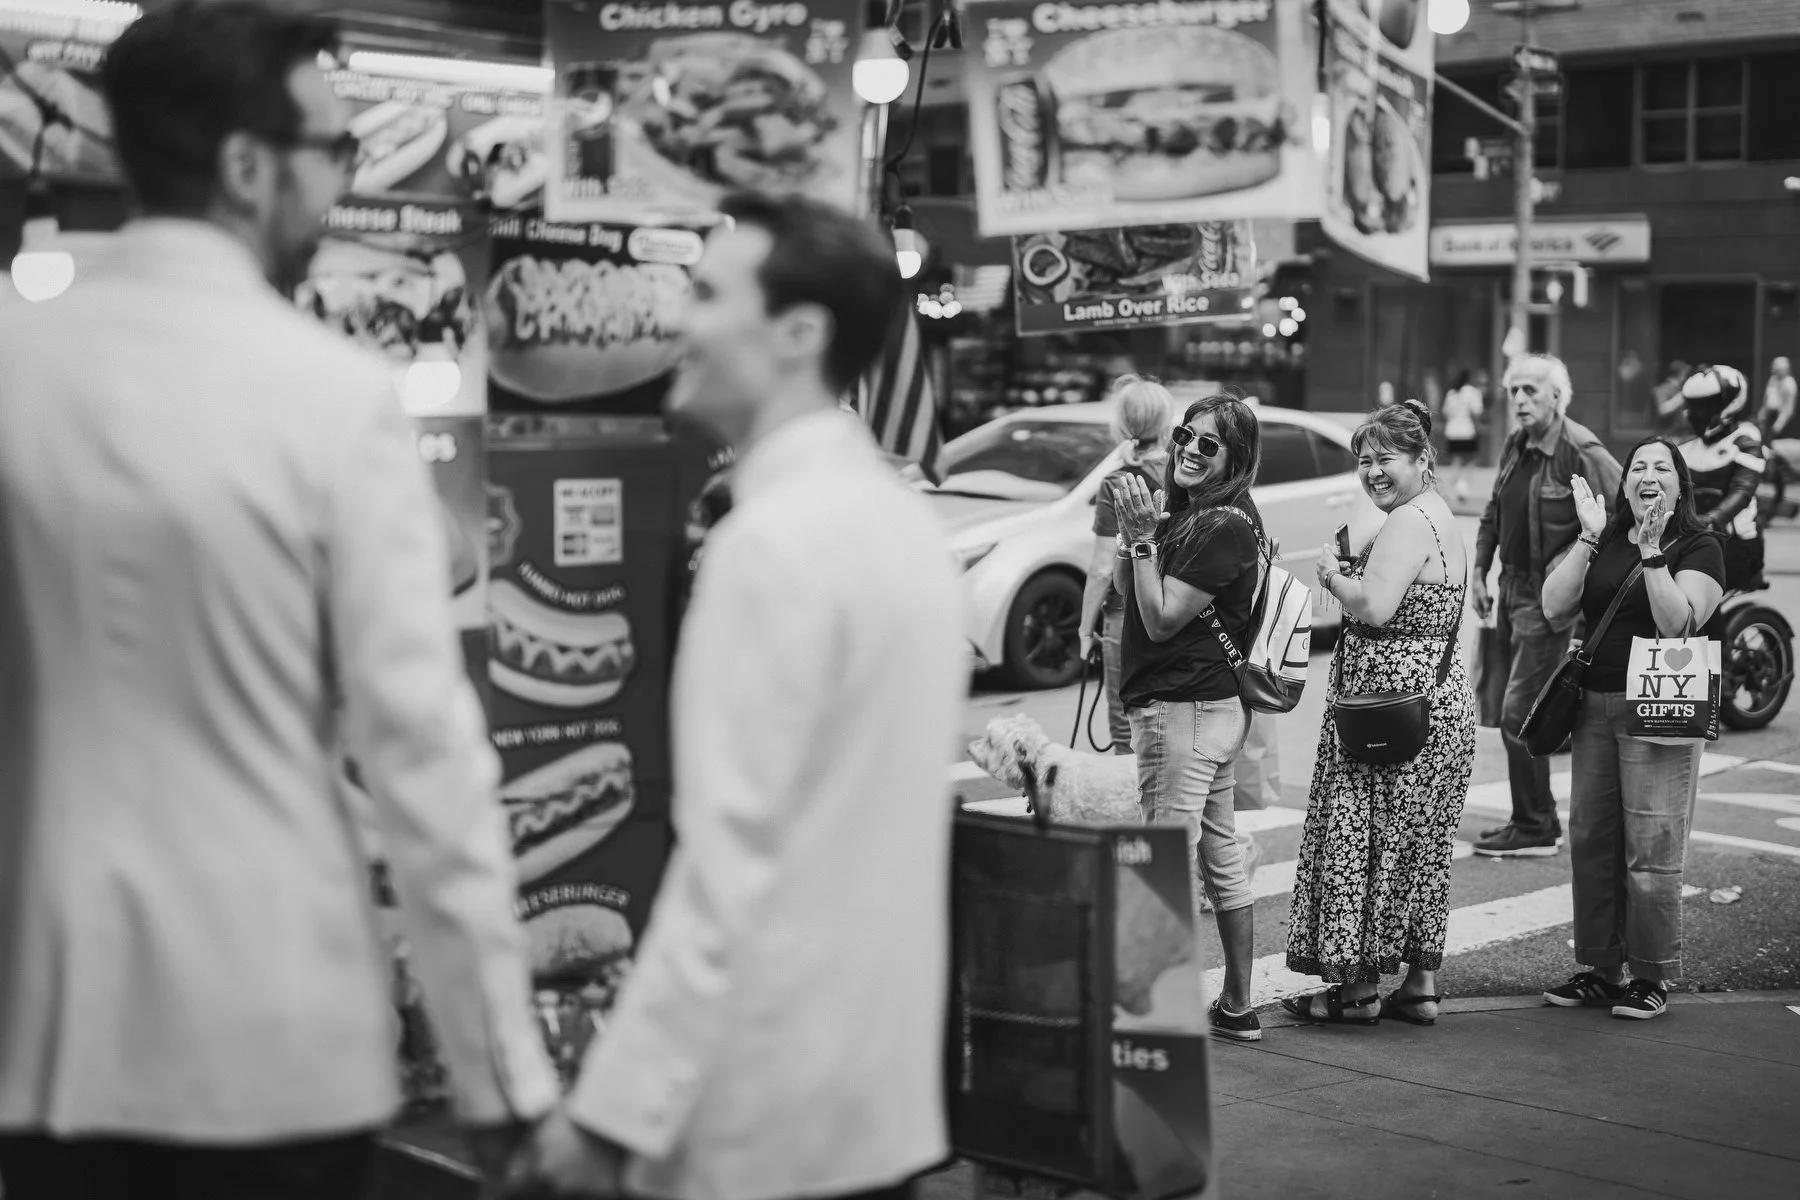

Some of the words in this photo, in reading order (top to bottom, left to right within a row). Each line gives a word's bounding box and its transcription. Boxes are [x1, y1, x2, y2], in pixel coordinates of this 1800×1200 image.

[600, 2, 724, 30] Chicken
[728, 0, 808, 33] Gyro
[1032, 0, 1271, 33] Cheeseburger
[321, 205, 397, 231] heese
[400, 204, 462, 234] Steak
[1161, 273, 1197, 292] With
[1201, 272, 1240, 290] Soda
[1063, 301, 1115, 322] Lamb
[1118, 299, 1162, 317] Over
[1166, 295, 1210, 314] Rice
[1646, 648, 1661, 671] I
[1637, 674, 1696, 699] NY
[1636, 703, 1695, 718] GIFTS
